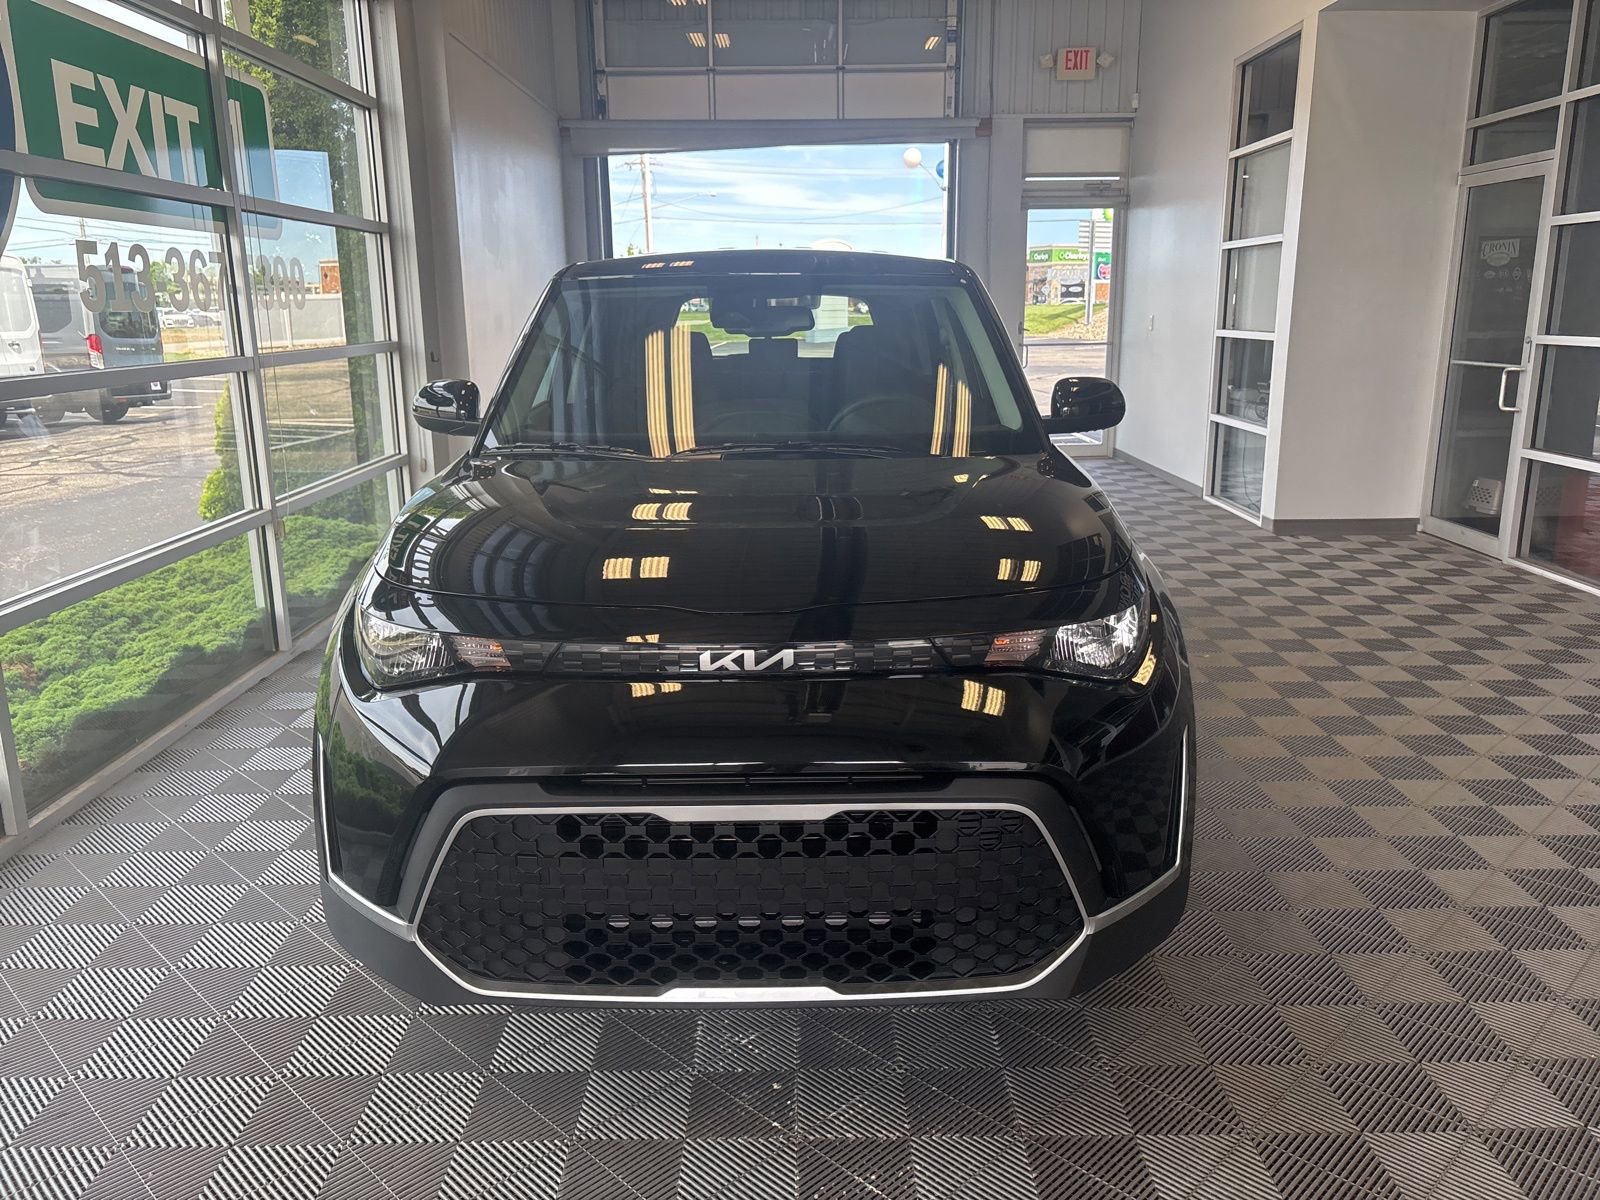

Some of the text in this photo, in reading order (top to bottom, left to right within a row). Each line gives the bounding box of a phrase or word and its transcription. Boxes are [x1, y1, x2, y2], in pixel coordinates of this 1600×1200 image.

[1065, 50, 1090, 70] EXIT
[51, 58, 200, 187] EXIT
[1482, 240, 1518, 257] CRONIN
[699, 649, 794, 671] KIA
